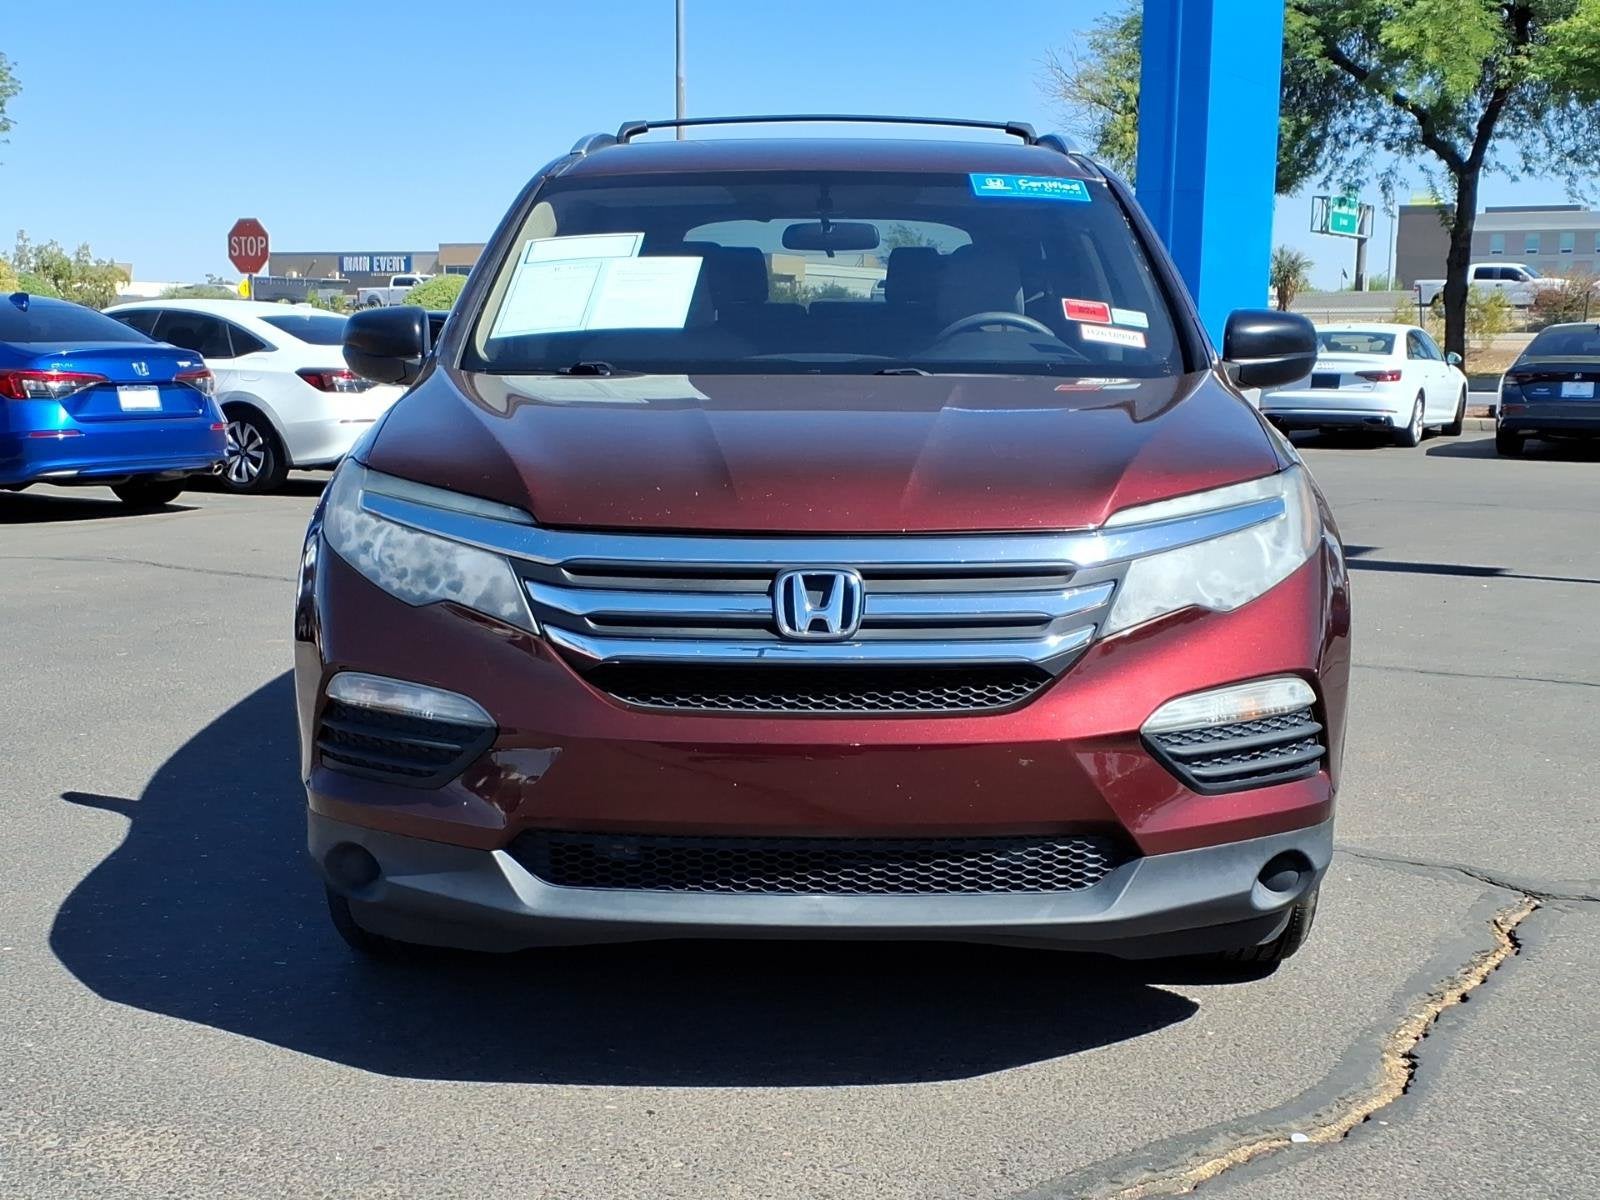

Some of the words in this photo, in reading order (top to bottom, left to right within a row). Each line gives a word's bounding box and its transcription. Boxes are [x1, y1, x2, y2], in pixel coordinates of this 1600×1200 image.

[1018, 178, 1080, 191] Certified
[230, 236, 266, 257] STOP
[343, 255, 370, 272] MAIN
[373, 255, 407, 272] EVENT
